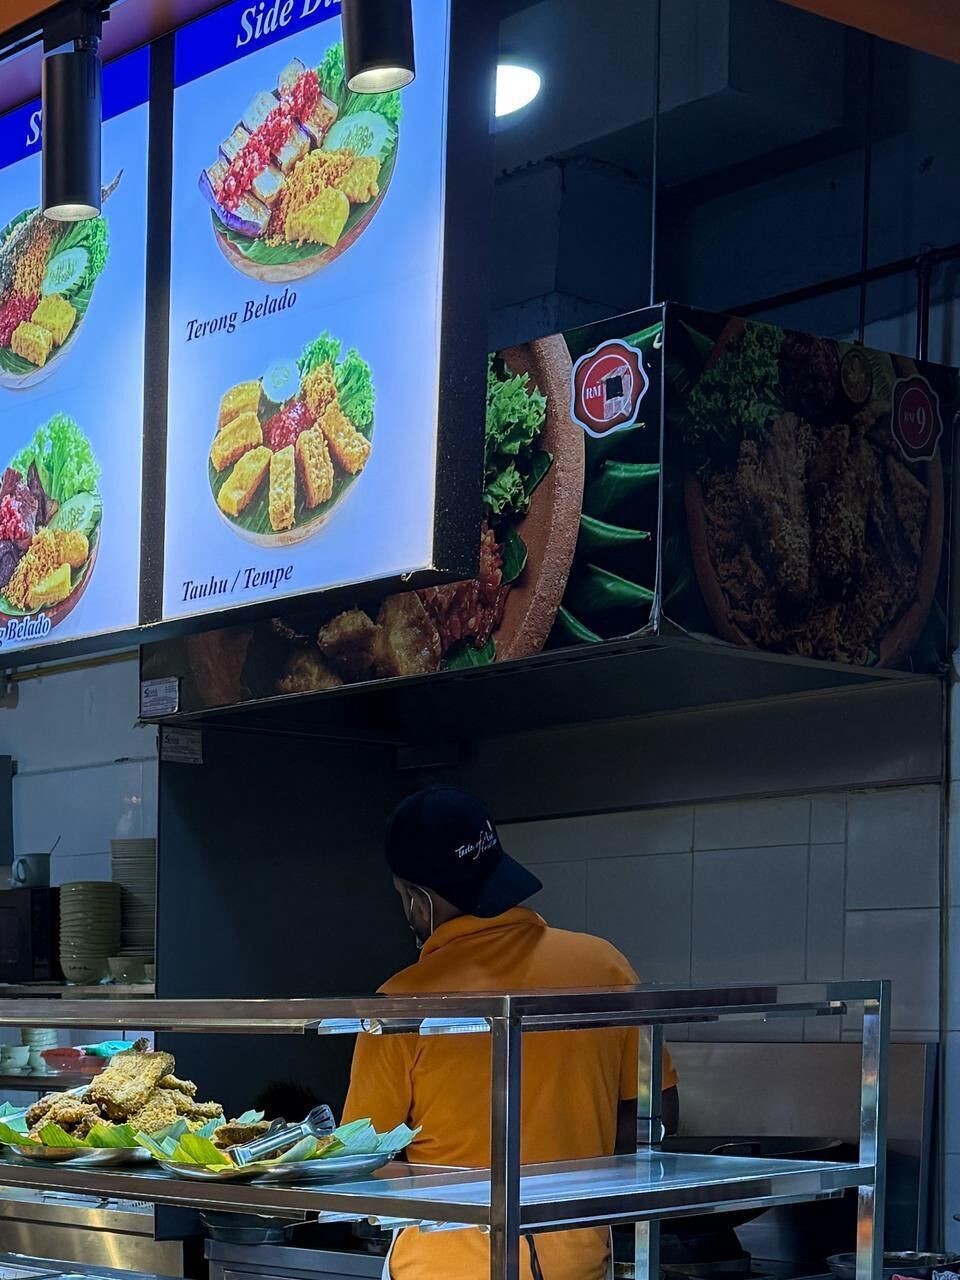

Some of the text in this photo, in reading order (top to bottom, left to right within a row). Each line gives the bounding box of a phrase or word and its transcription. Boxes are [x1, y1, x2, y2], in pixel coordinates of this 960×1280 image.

[236, 0, 292, 48] Side
[185, 288, 298, 342] Terong Belado
[181, 561, 294, 602] Tauhu / Tempe
[6, 615, 52, 641] Belado
